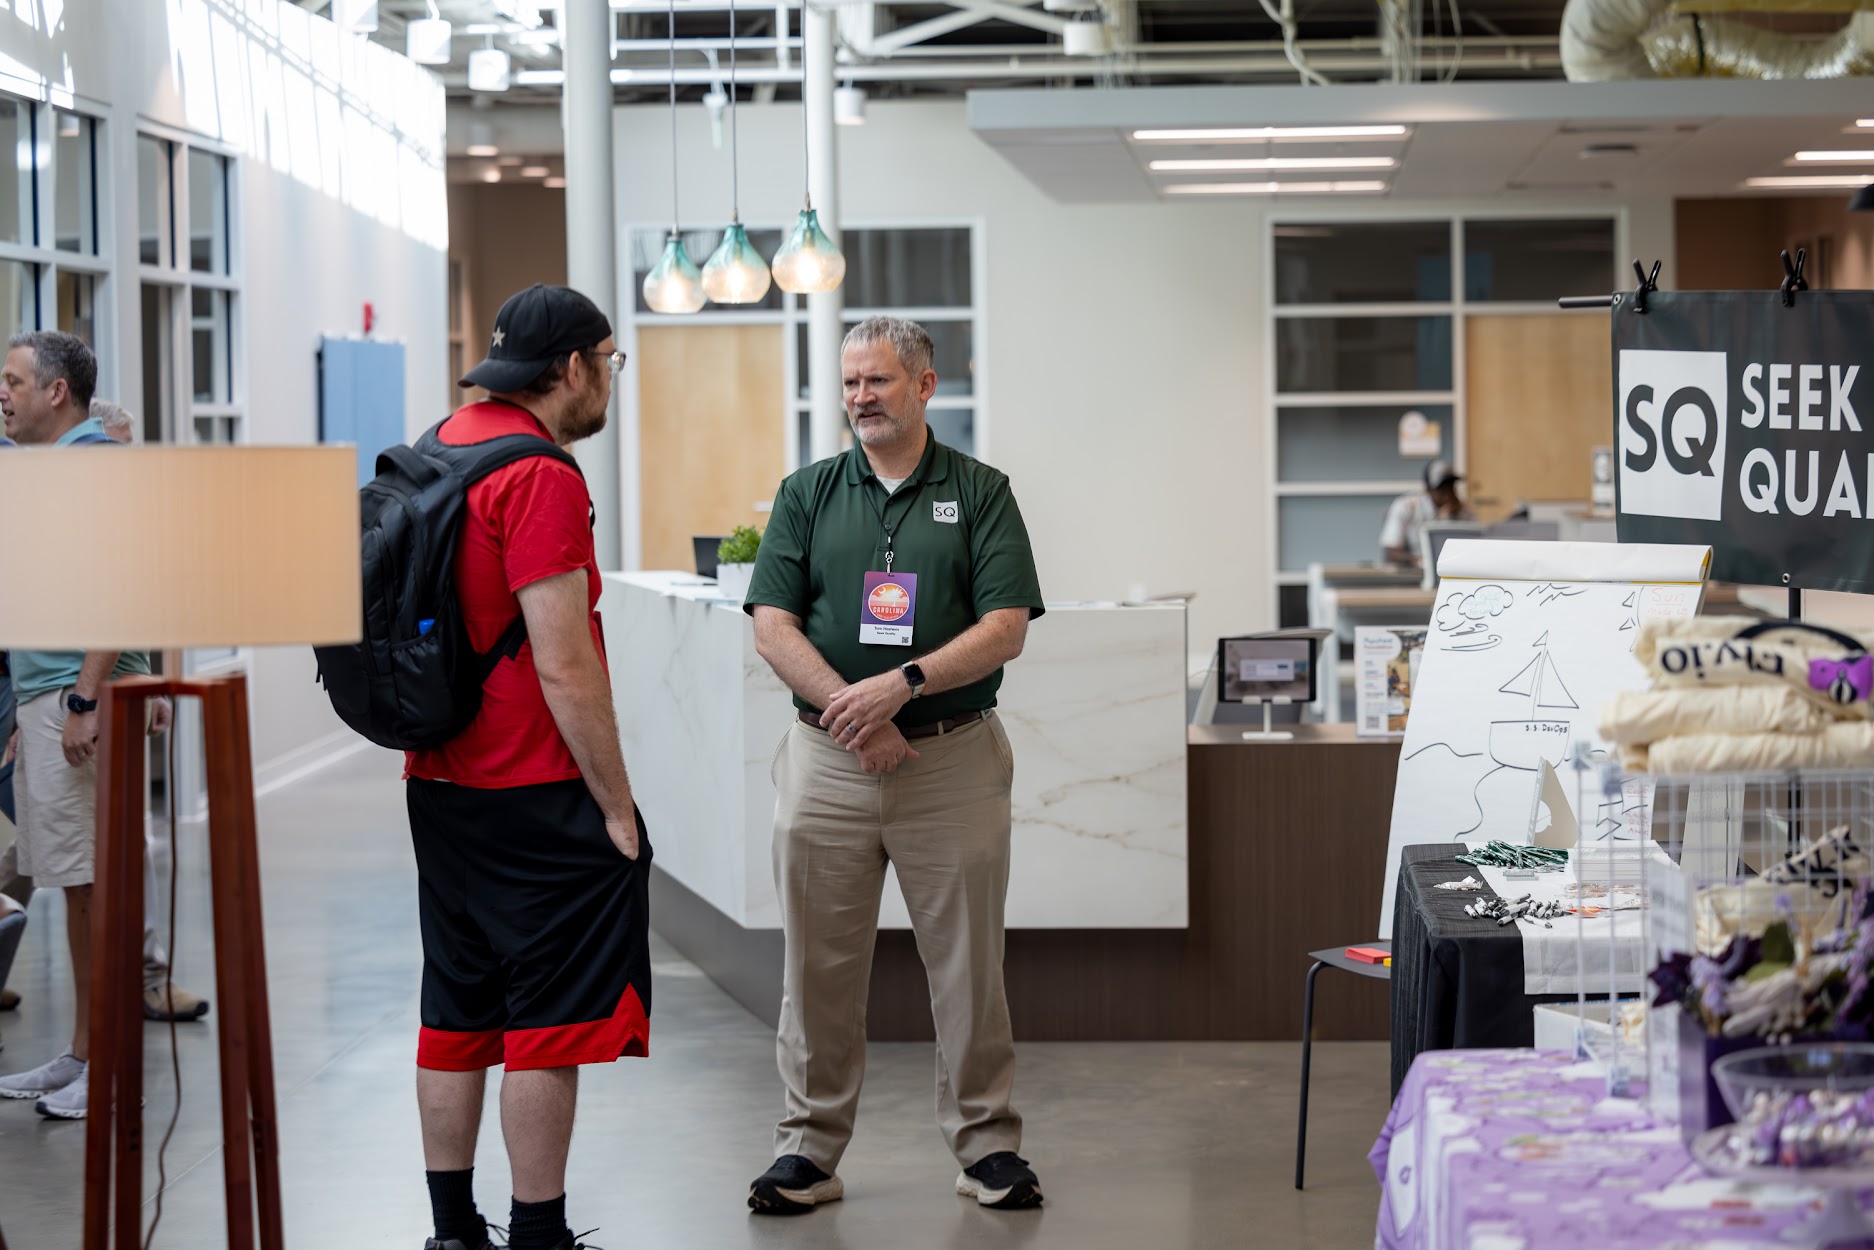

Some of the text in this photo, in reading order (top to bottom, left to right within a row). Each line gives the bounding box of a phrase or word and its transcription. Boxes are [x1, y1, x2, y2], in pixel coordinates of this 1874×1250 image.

[1740, 363, 1863, 432] SEEK
[1625, 384, 1718, 477] SQ
[935, 506, 956, 518] SQ
[1651, 587, 1685, 602] Sun
[872, 606, 904, 614] CAROLINA
[1542, 724, 1568, 736] DevOps
